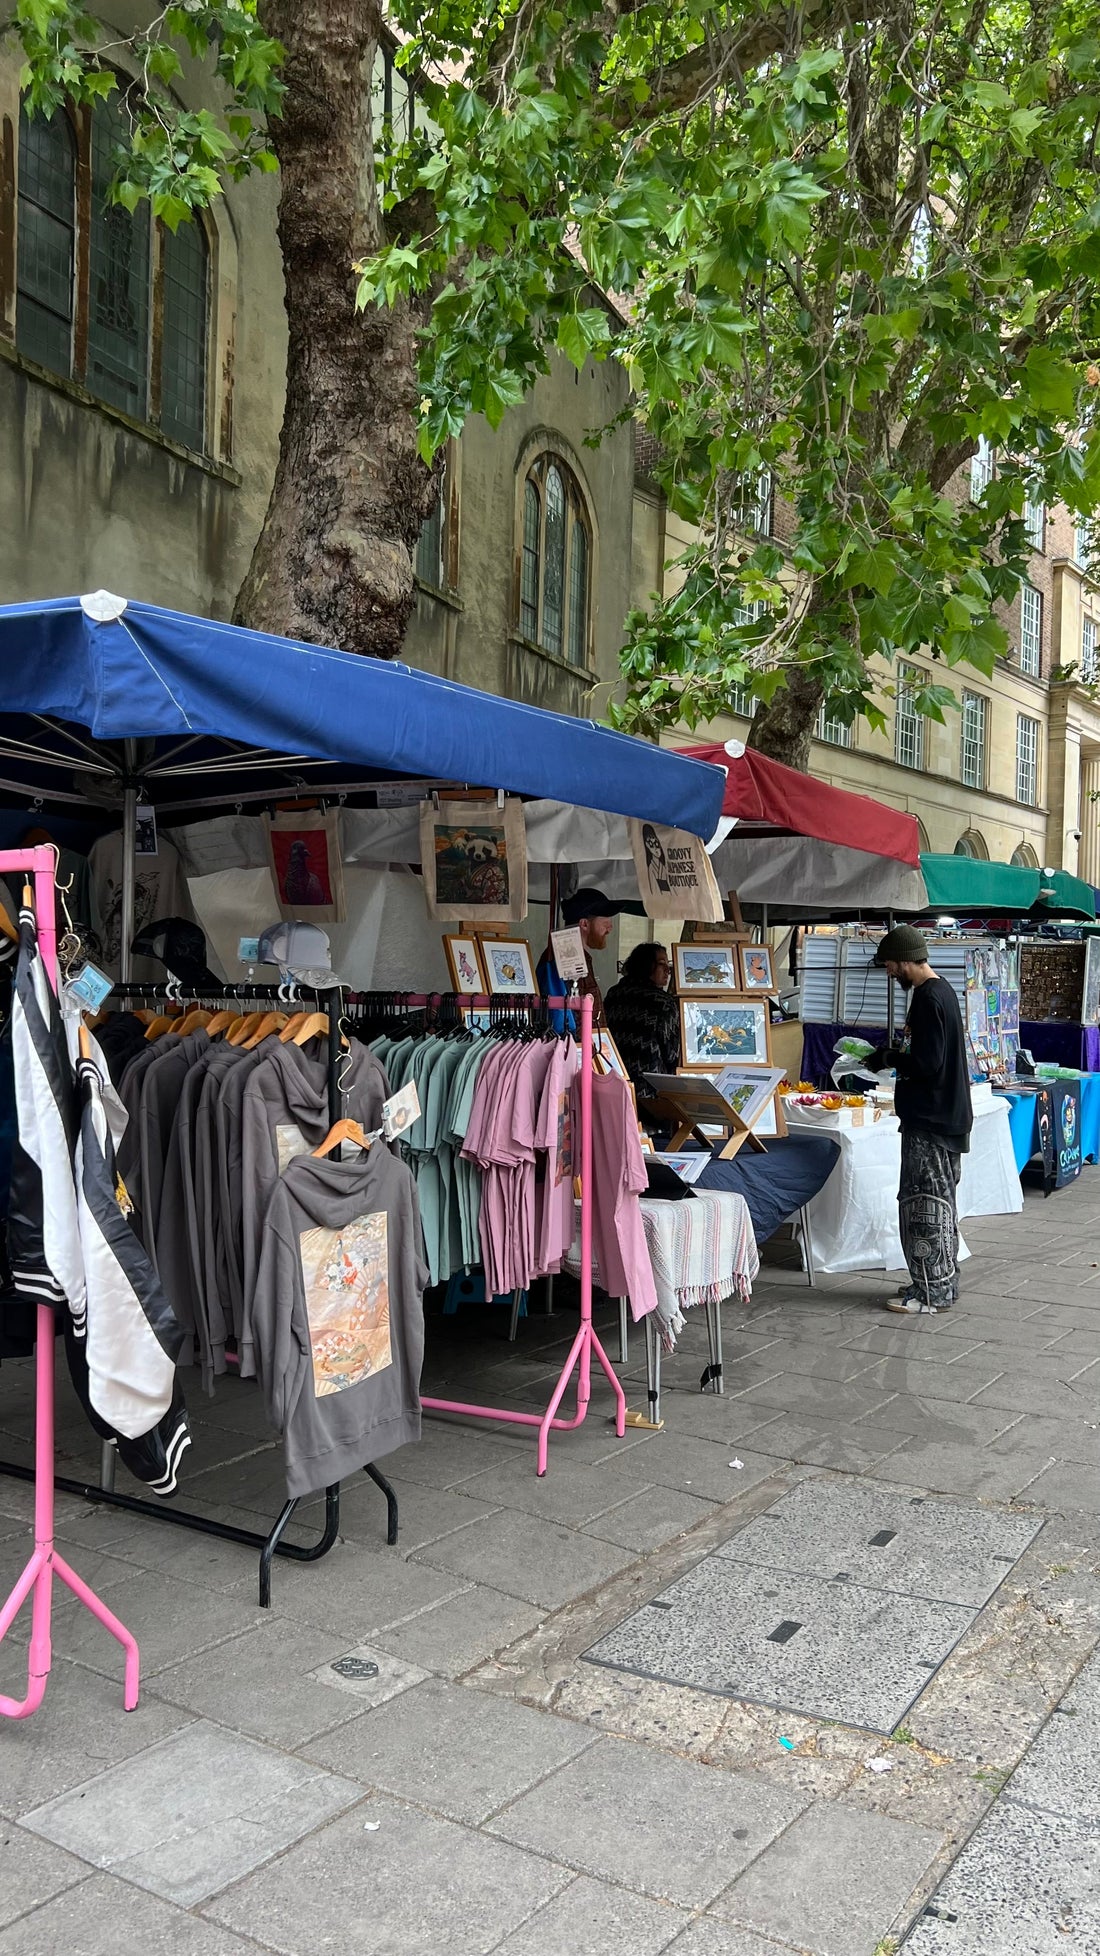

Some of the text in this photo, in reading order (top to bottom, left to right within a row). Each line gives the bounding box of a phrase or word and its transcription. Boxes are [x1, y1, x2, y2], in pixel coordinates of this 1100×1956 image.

[667, 847, 691, 860] GROOVY
[667, 861, 695, 873] JAPANESE
[668, 874, 698, 888] BOUTIQUE
